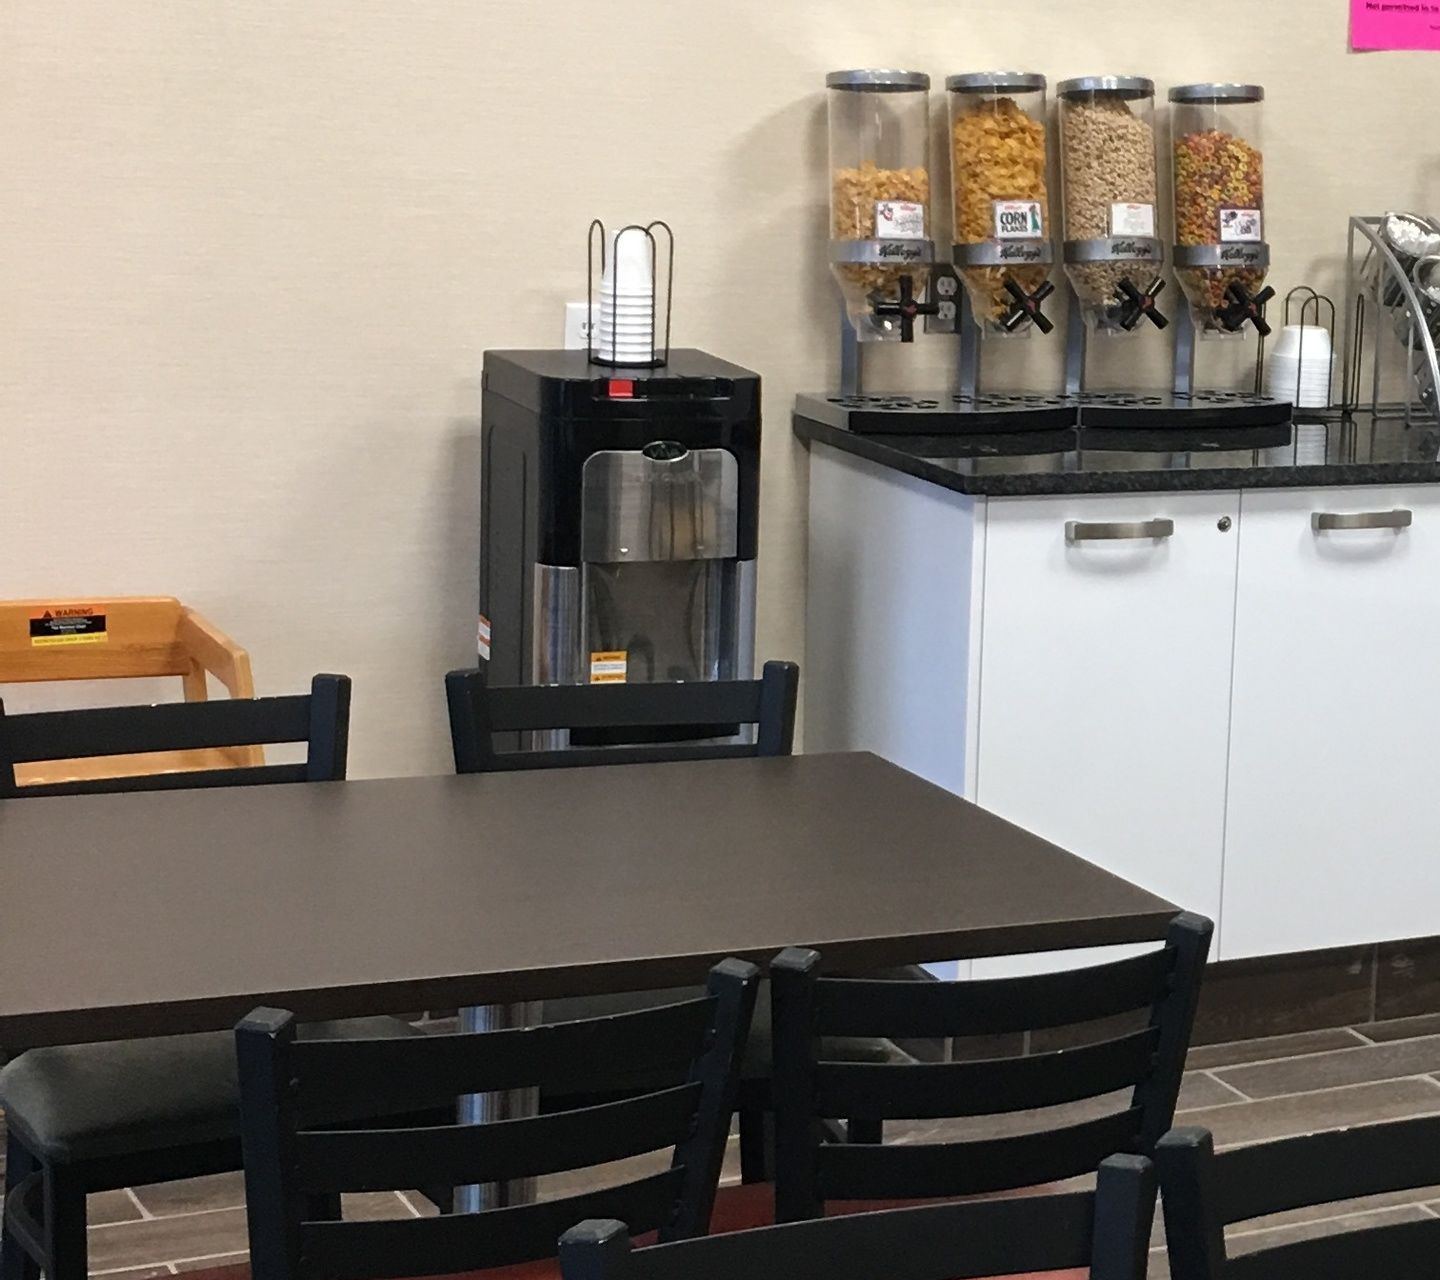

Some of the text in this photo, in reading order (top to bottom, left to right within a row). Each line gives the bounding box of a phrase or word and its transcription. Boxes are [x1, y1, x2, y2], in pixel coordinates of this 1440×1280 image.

[1000, 211, 1028, 225] CORN
[1001, 225, 1029, 233] FLAKES
[54, 608, 94, 617] WARNING
